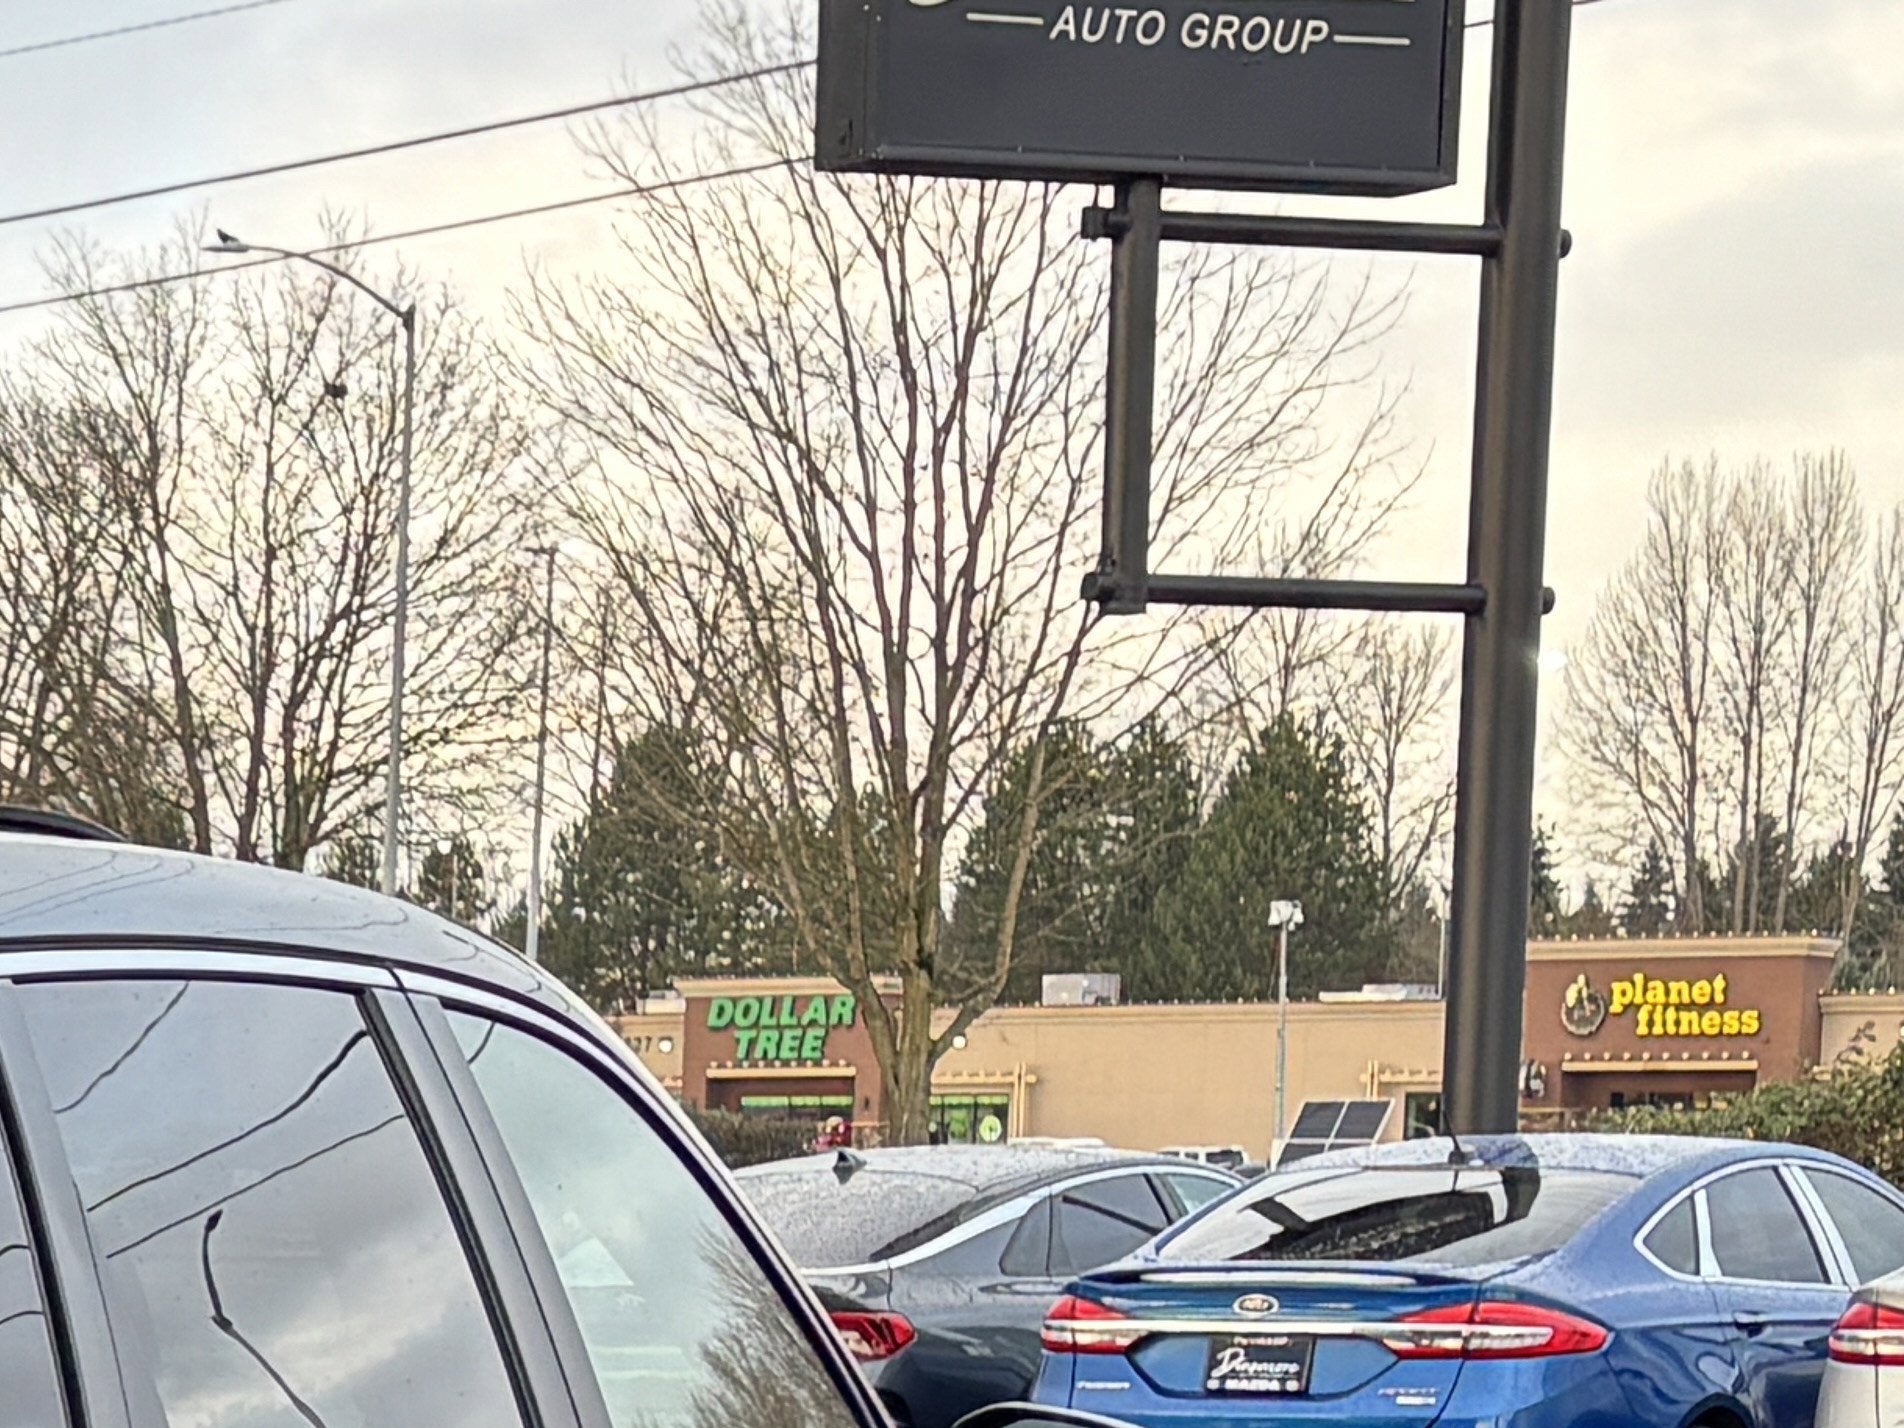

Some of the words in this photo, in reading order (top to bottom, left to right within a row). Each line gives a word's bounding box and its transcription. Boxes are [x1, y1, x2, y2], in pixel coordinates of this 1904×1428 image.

[1049, 7, 1166, 47] AUTO
[1180, 14, 1330, 54] GROUP
[1608, 972, 1727, 1015] planet
[705, 995, 856, 1028] DOLLAR
[1635, 1004, 1760, 1037] fitness
[733, 1028, 828, 1060] TREE
